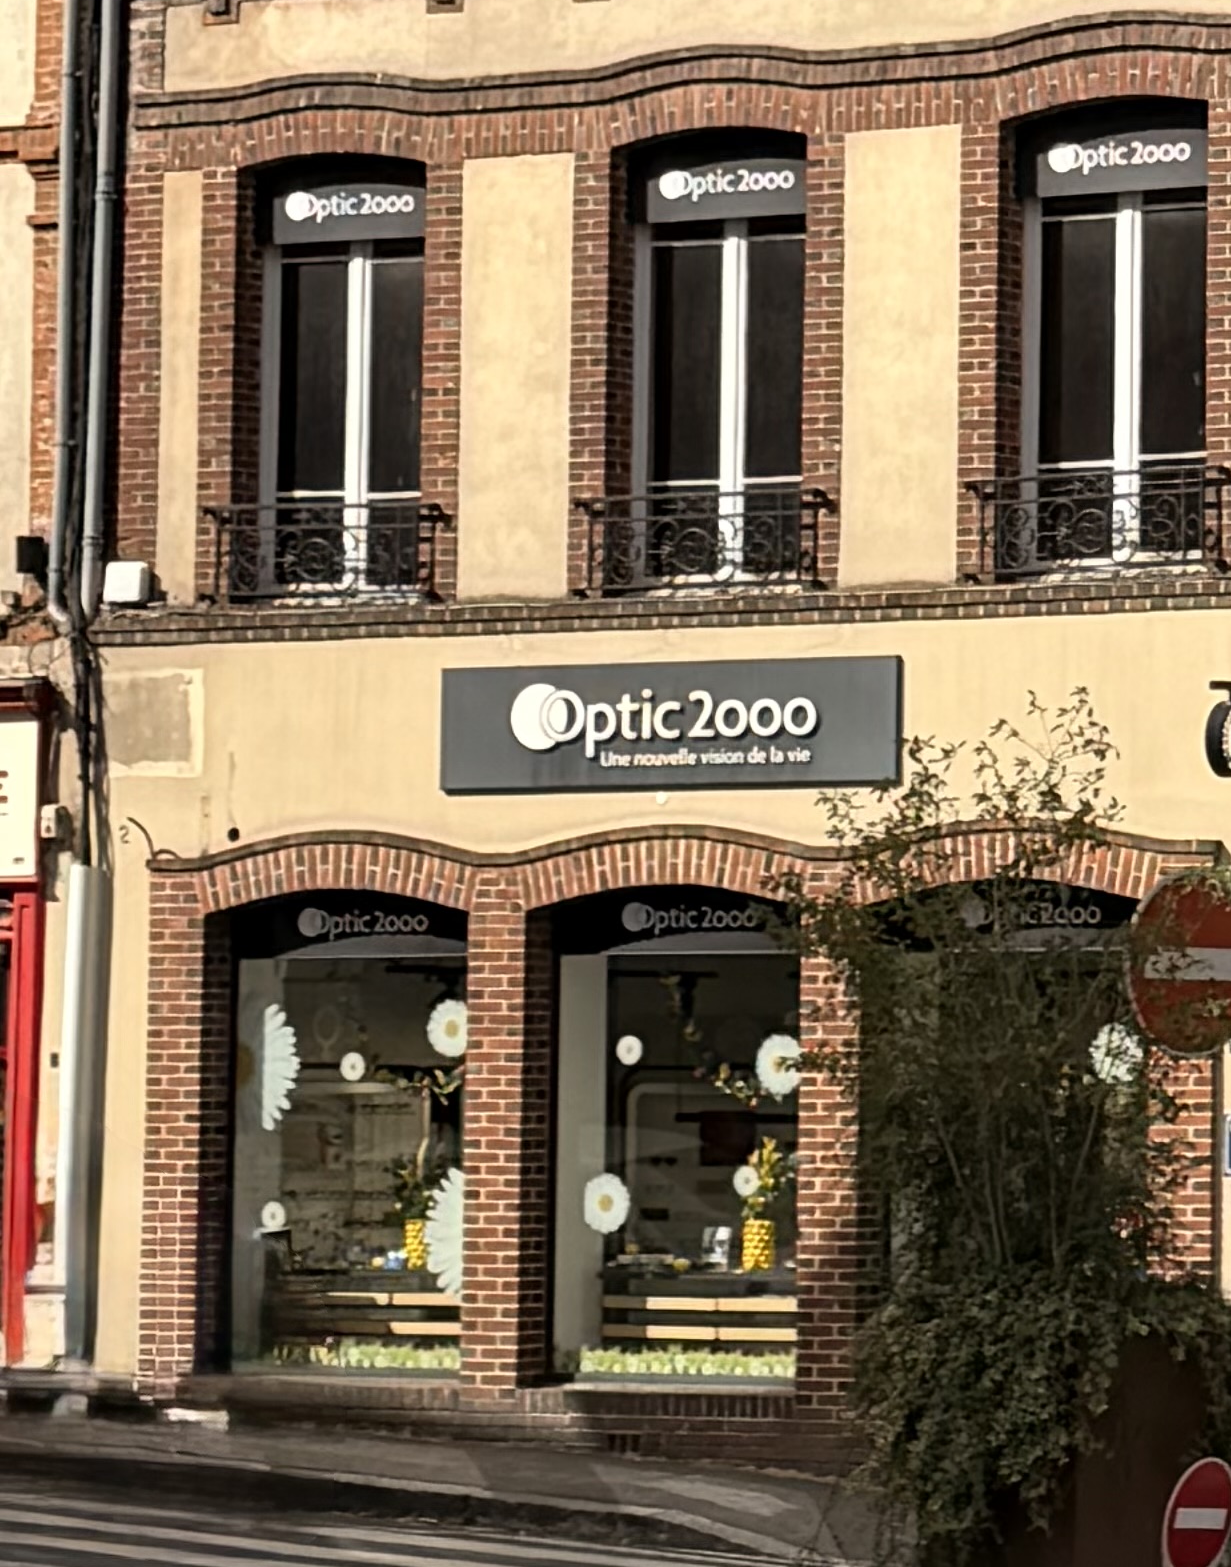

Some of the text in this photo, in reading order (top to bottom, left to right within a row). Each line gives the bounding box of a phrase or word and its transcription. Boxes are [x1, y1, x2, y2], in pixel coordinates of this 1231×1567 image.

[1057, 140, 1191, 175] Optic 2000
[667, 168, 796, 202] Optic 2000
[294, 190, 415, 223] Optic 2000
[540, 688, 818, 758] Optic 2000
[600, 745, 811, 768] Une nouvelle vision de la vie
[306, 908, 429, 941] Optic 2000
[632, 904, 757, 936] Optic 2000
